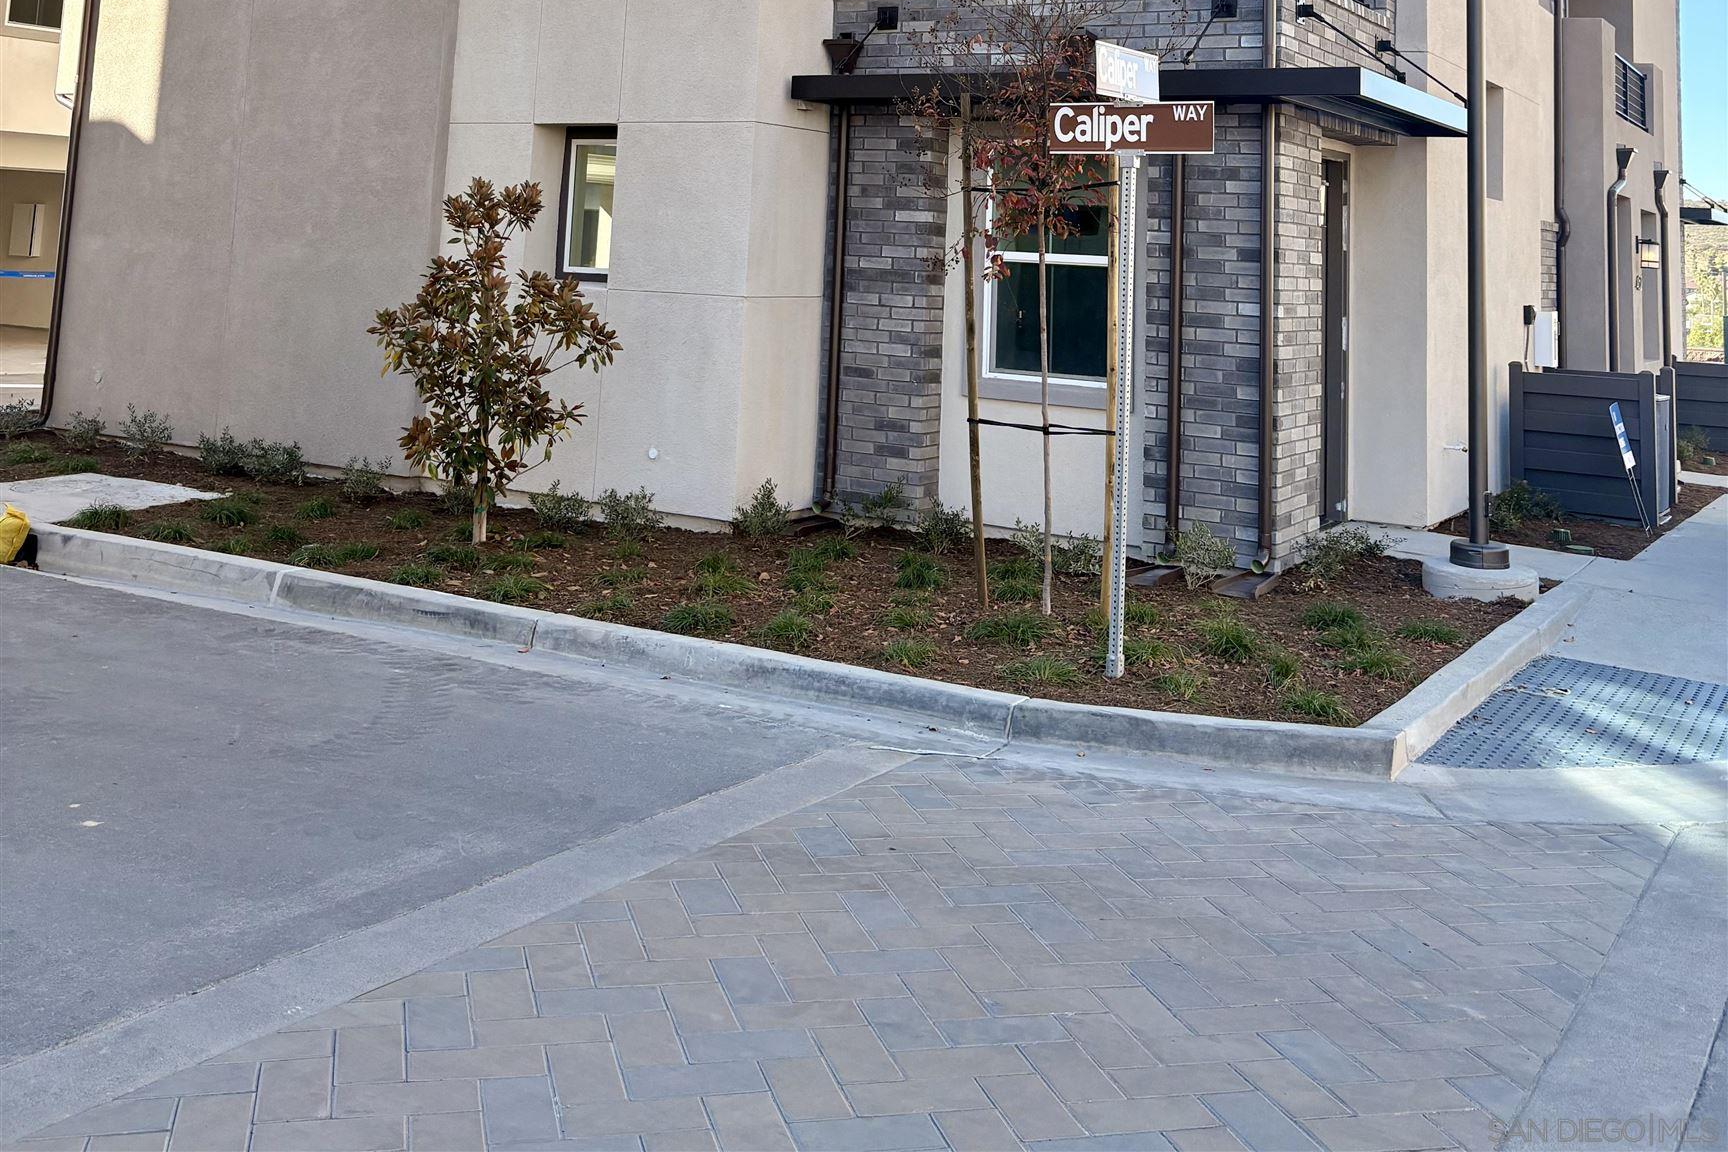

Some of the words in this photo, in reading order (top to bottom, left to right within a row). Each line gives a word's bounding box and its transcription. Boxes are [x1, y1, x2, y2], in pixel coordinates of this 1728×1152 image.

[1099, 46, 1139, 95] Caliper
[1054, 105, 1154, 150] Caliper
[1173, 105, 1208, 121] WAY
